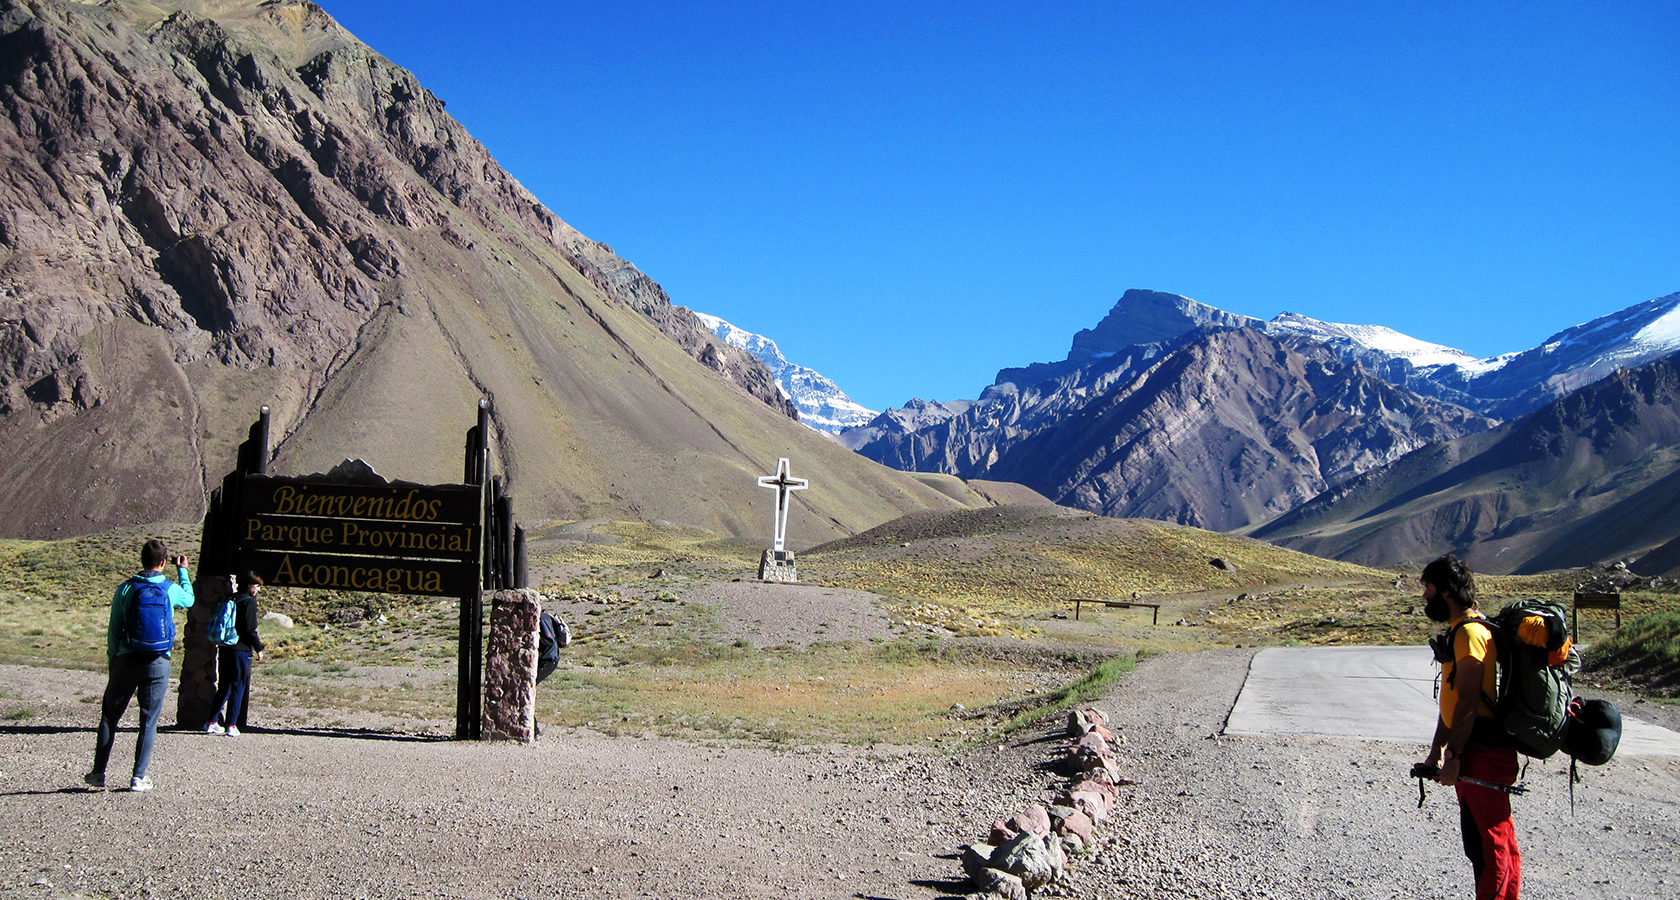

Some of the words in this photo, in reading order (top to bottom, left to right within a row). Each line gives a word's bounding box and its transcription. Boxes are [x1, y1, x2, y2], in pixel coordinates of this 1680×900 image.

[273, 485, 442, 520] Bienvenidos
[244, 518, 334, 547] Parque
[340, 522, 473, 552] Provincial
[272, 554, 443, 593] Aconcagua
